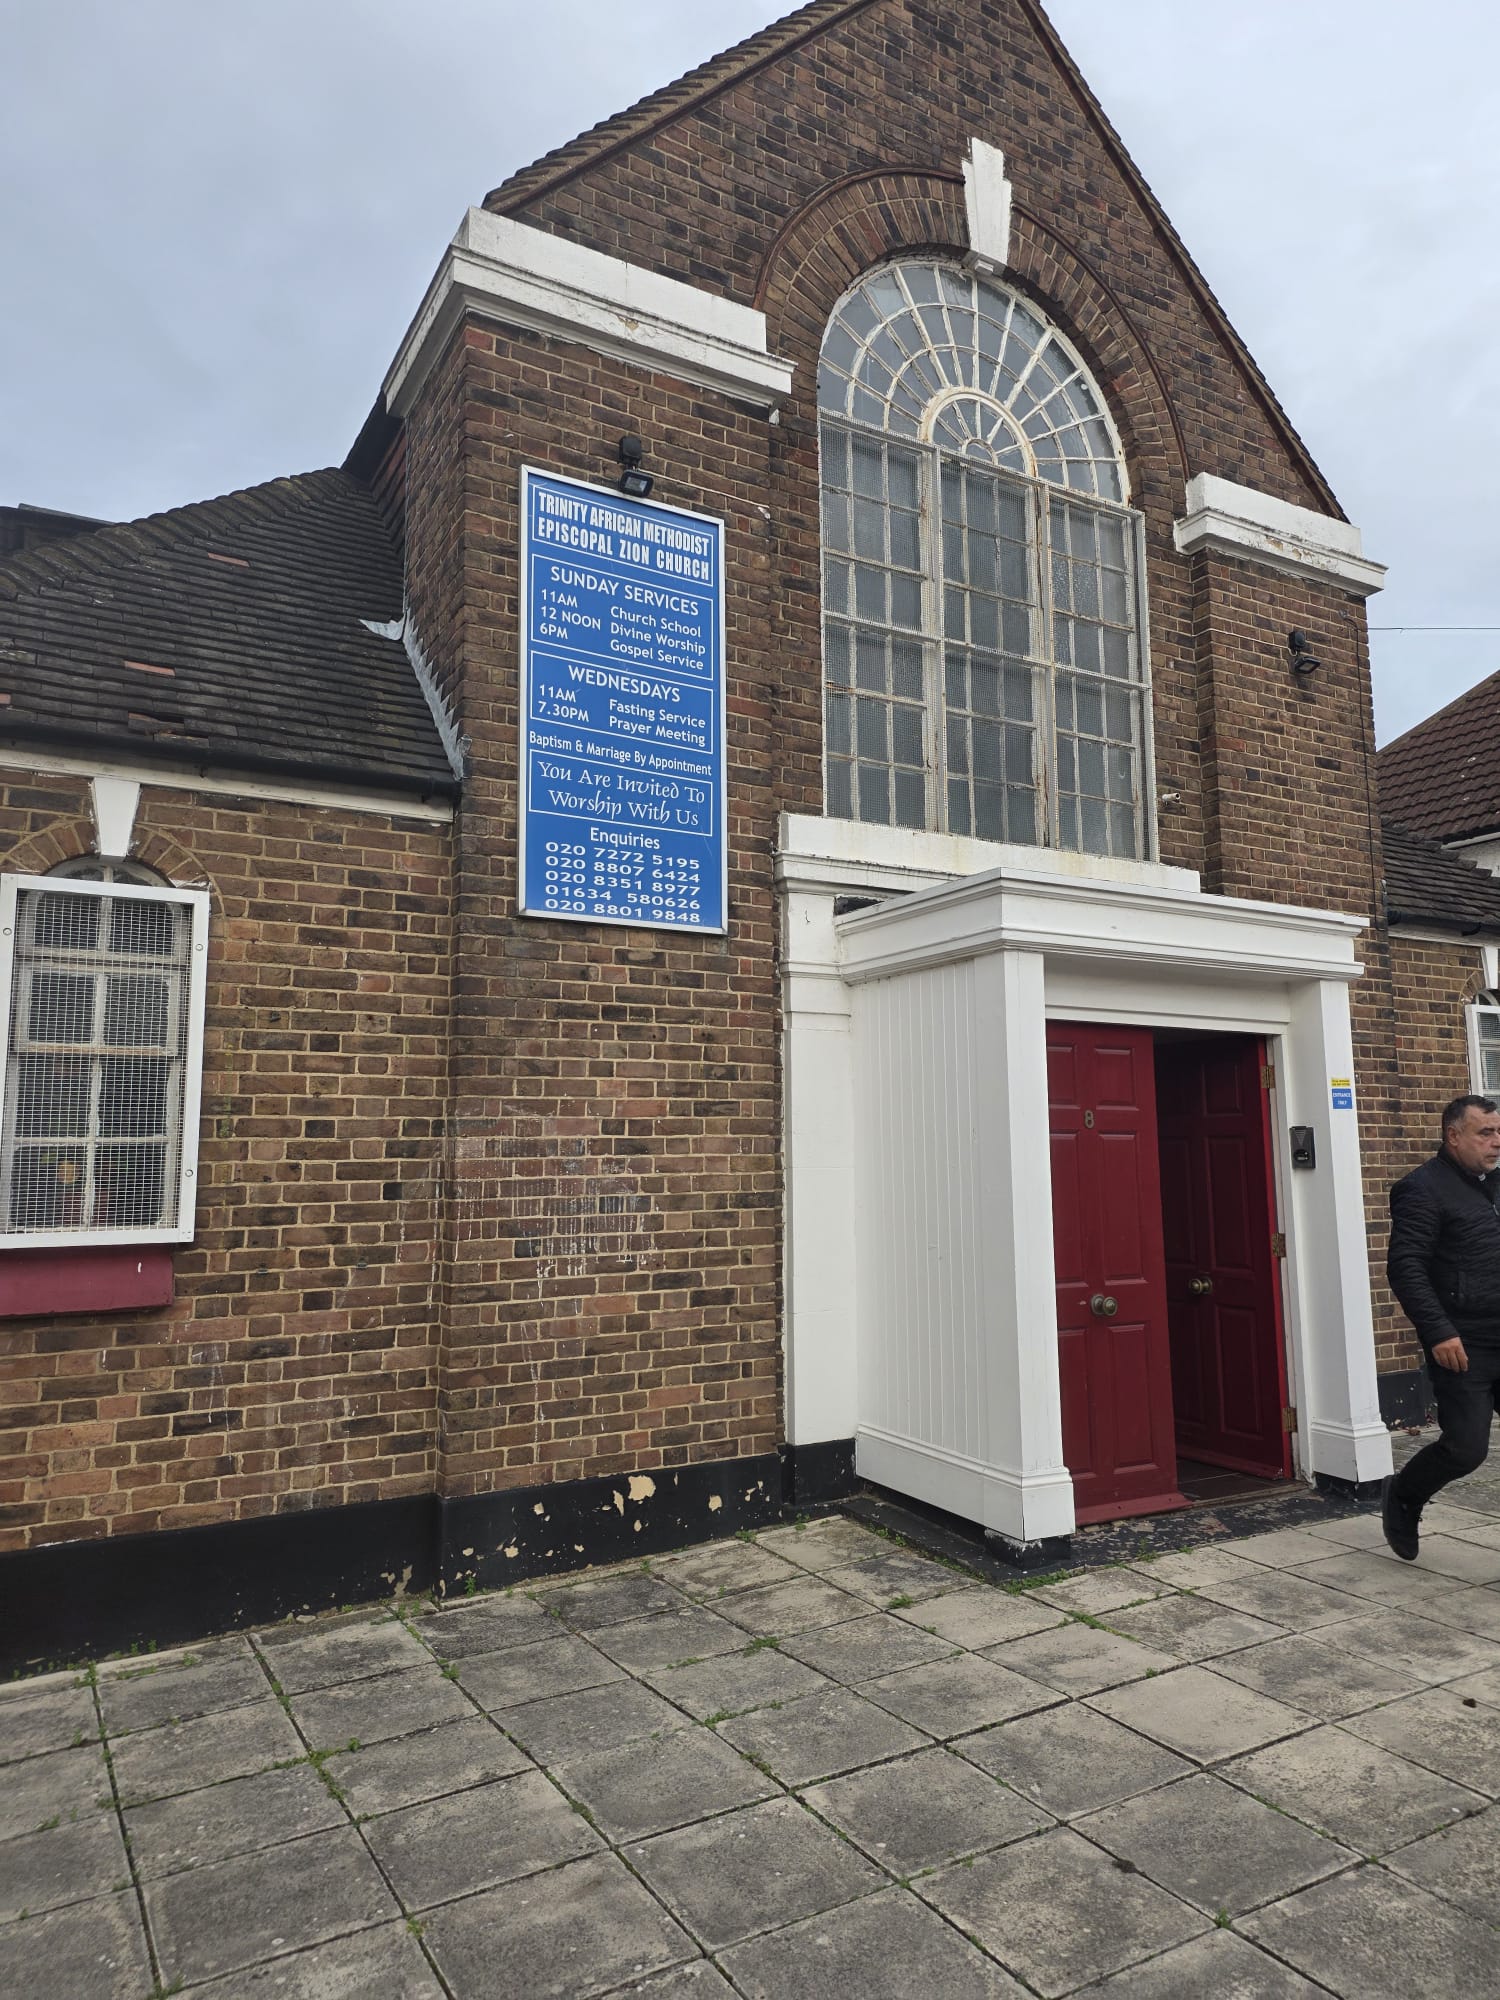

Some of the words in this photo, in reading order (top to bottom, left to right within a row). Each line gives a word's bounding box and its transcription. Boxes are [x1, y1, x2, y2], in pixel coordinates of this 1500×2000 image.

[538, 491, 588, 523] TRINITY
[589, 506, 641, 538] AFRICAN
[643, 521, 709, 556] METHODIST
[538, 516, 612, 555] EPISCOPAL
[619, 538, 649, 565] ZION
[656, 549, 708, 580] CHURCH
[550, 565, 619, 595] SUNDAY
[624, 584, 698, 615] SERVICES
[541, 588, 577, 608] 11AM
[610, 606, 656, 627] Church
[660, 617, 700, 637] School
[541, 605, 556, 619] 12
[562, 610, 600, 630] NOON
[610, 621, 651, 642] Divine
[655, 632, 705, 656] Worship
[539, 622, 568, 639] 6PM
[610, 639, 653, 659] Gospel
[657, 649, 703, 670] Service
[568, 664, 680, 702] WEDNESDAYS
[538, 700, 589, 722] 7.30PM
[609, 715, 651, 734] Prayer
[655, 725, 705, 747] Meeting
[539, 684, 576, 702] 11AM
[609, 698, 655, 721] Fasting
[659, 709, 705, 728] Service
[529, 730, 571, 750] Baptism
[575, 739, 583, 752] &
[586, 742, 631, 762] Marriage
[634, 750, 646, 766] By
[648, 754, 711, 776] Appointment
[537, 761, 571, 780] You
[577, 769, 610, 787] Are
[617, 775, 679, 798] Invited
[684, 786, 704, 803] To
[548, 789, 621, 819] Worship
[627, 800, 670, 823] With
[676, 809, 698, 825] Us
[545, 841, 585, 855] 020
[593, 847, 644, 862] 7272
[652, 854, 699, 869] 5195
[590, 826, 659, 849] Enquiries
[545, 855, 585, 869] 020
[593, 861, 644, 876] 8807
[652, 868, 700, 882] 6424
[545, 870, 585, 883] 020
[593, 875, 641, 890] 8351
[652, 882, 700, 895] 8977
[545, 884, 611, 900] 01634
[627, 892, 700, 909] 580626
[545, 898, 585, 911] 020
[593, 903, 641, 917] 8801
[651, 909, 700, 923] 9848
